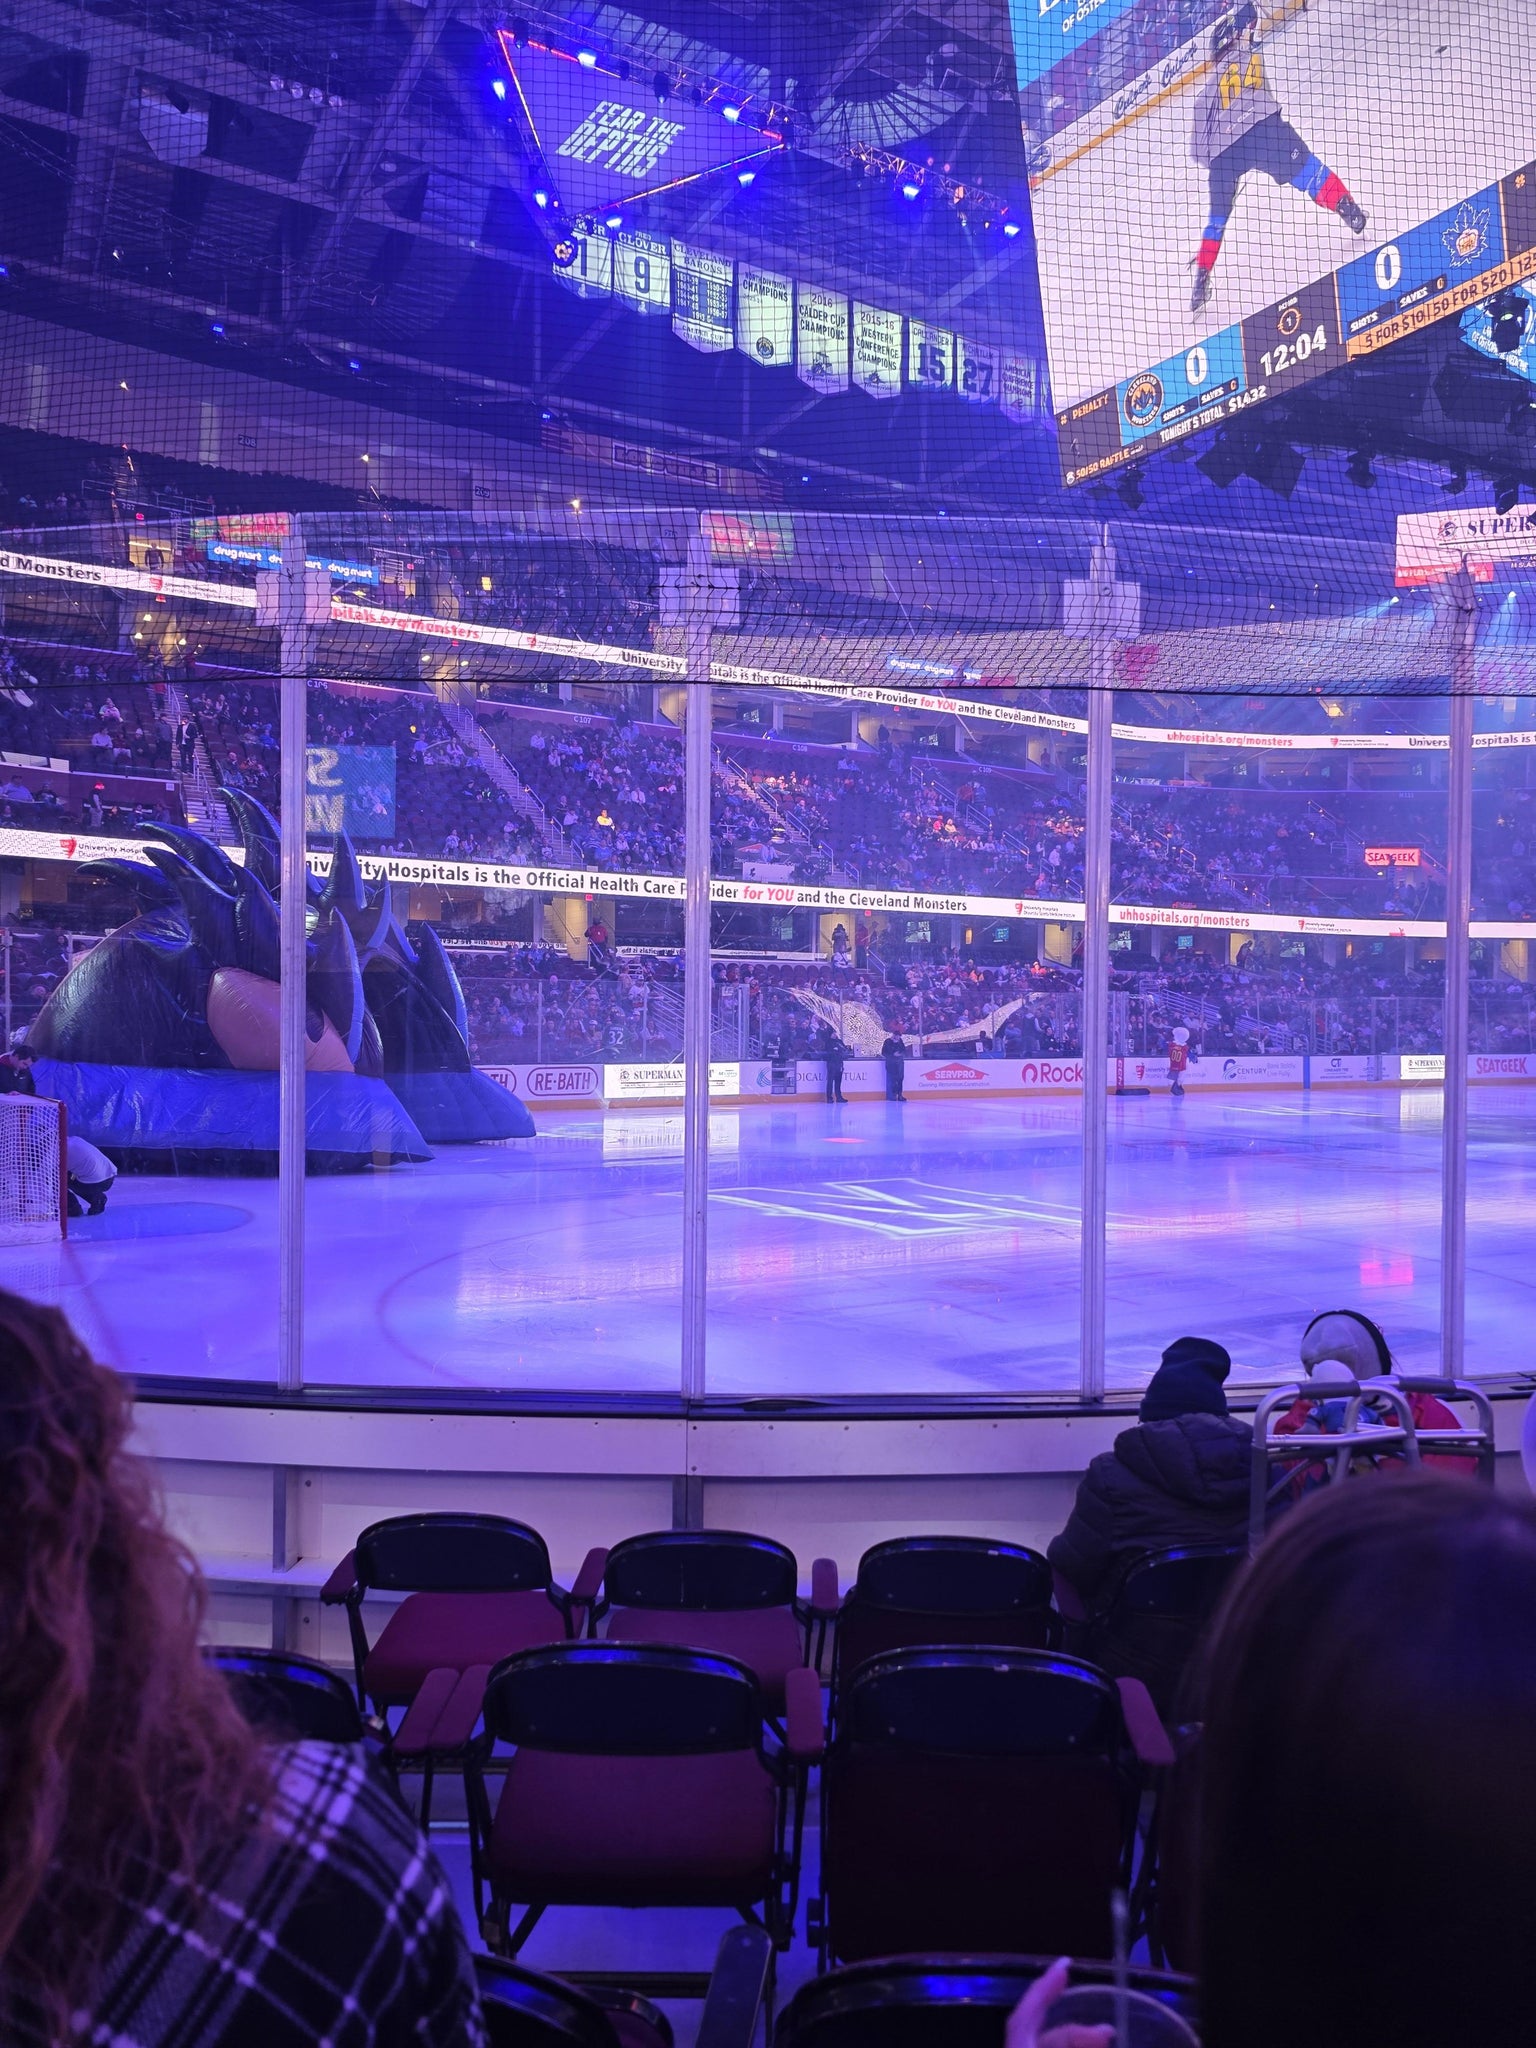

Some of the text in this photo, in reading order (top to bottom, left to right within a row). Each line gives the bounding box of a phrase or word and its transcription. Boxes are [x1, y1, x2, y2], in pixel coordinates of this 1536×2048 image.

[1062, 14, 1075, 32] OF
[588, 100, 686, 145] FEAR THE
[555, 120, 668, 178] DEPTHS
[619, 232, 667, 255] GLOVER
[674, 244, 732, 268] CLEVELAND
[683, 257, 723, 275] BARONS
[634, 256, 650, 294] 9
[1375, 245, 1401, 290] 0
[742, 280, 789, 302] CHAMPIONS
[811, 293, 833, 308] 2016
[1376, 324, 1400, 343] FOR
[1402, 310, 1424, 331] $10
[1433, 297, 1449, 317] 50
[1453, 283, 1478, 307] FOR
[1481, 268, 1507, 293] $20
[1518, 253, 1536, 273] 12
[1400, 287, 1428, 308] SAVES
[799, 305, 846, 328] CALDER CUP
[861, 312, 895, 330] 2015-16
[1350, 311, 1379, 333] SHOTS
[800, 319, 845, 341] CHAMPIONS
[861, 327, 894, 345] WESTERN
[913, 327, 950, 346] CALLANDER
[856, 336, 899, 359] CONFERENCE
[1259, 324, 1327, 377] 12:04
[857, 352, 897, 371] CHAMPIONS
[917, 343, 946, 381] 15
[1185, 347, 1207, 386] 0
[963, 359, 993, 396] 27
[1072, 393, 1109, 419] PENALTY
[1201, 387, 1224, 404] SAVES
[1159, 415, 1200, 443] TONIGHT'S
[1199, 405, 1226, 426] TOTAL
[1162, 405, 1186, 422] SHOTS
[1099, 448, 1131, 469] RAFFLE
[16, 557, 102, 582] Monsters
[332, 606, 480, 640] pitals.org/monsters
[621, 650, 683, 672] University
[709, 664, 738, 679] pitals
[740, 669, 750, 681] is
[752, 671, 770, 685] the
[772, 675, 812, 691] Official
[851, 687, 873, 699] Care
[876, 690, 918, 706] Provider
[920, 697, 935, 708] for
[936, 699, 957, 712] YOU
[958, 704, 976, 714] and
[978, 706, 993, 718] the
[995, 708, 1037, 724] Cleveland
[1039, 716, 1076, 730] Monsters
[1167, 731, 1293, 747] uhhospitals.org/monsters
[1408, 736, 1450, 748] Universi
[1521, 733, 1532, 744] is
[120, 846, 142, 855] Hospi
[1367, 852, 1416, 863] SEATGEEK
[388, 862, 471, 883] Hospitals
[475, 867, 488, 883] is
[493, 868, 521, 885] the
[526, 871, 584, 889] Official
[589, 876, 639, 893] Health
[643, 880, 676, 895] Care
[680, 884, 739, 900] Pider
[743, 885, 764, 900] for
[767, 887, 795, 902] YOU
[797, 890, 821, 903] and
[824, 891, 846, 905] the
[849, 892, 910, 908] Cleveland
[913, 896, 968, 911] Monsters
[1119, 908, 1250, 927] uhhospitals.org/monsters
[608, 1030, 624, 1045] 32
[1171, 1049, 1183, 1062] 00
[1476, 1057, 1528, 1074] SEATGEEK
[633, 1069, 683, 1080] SUPERMAN
[796, 1072, 867, 1081] DICAL TUAL
[1040, 1062, 1083, 1083] Rock
